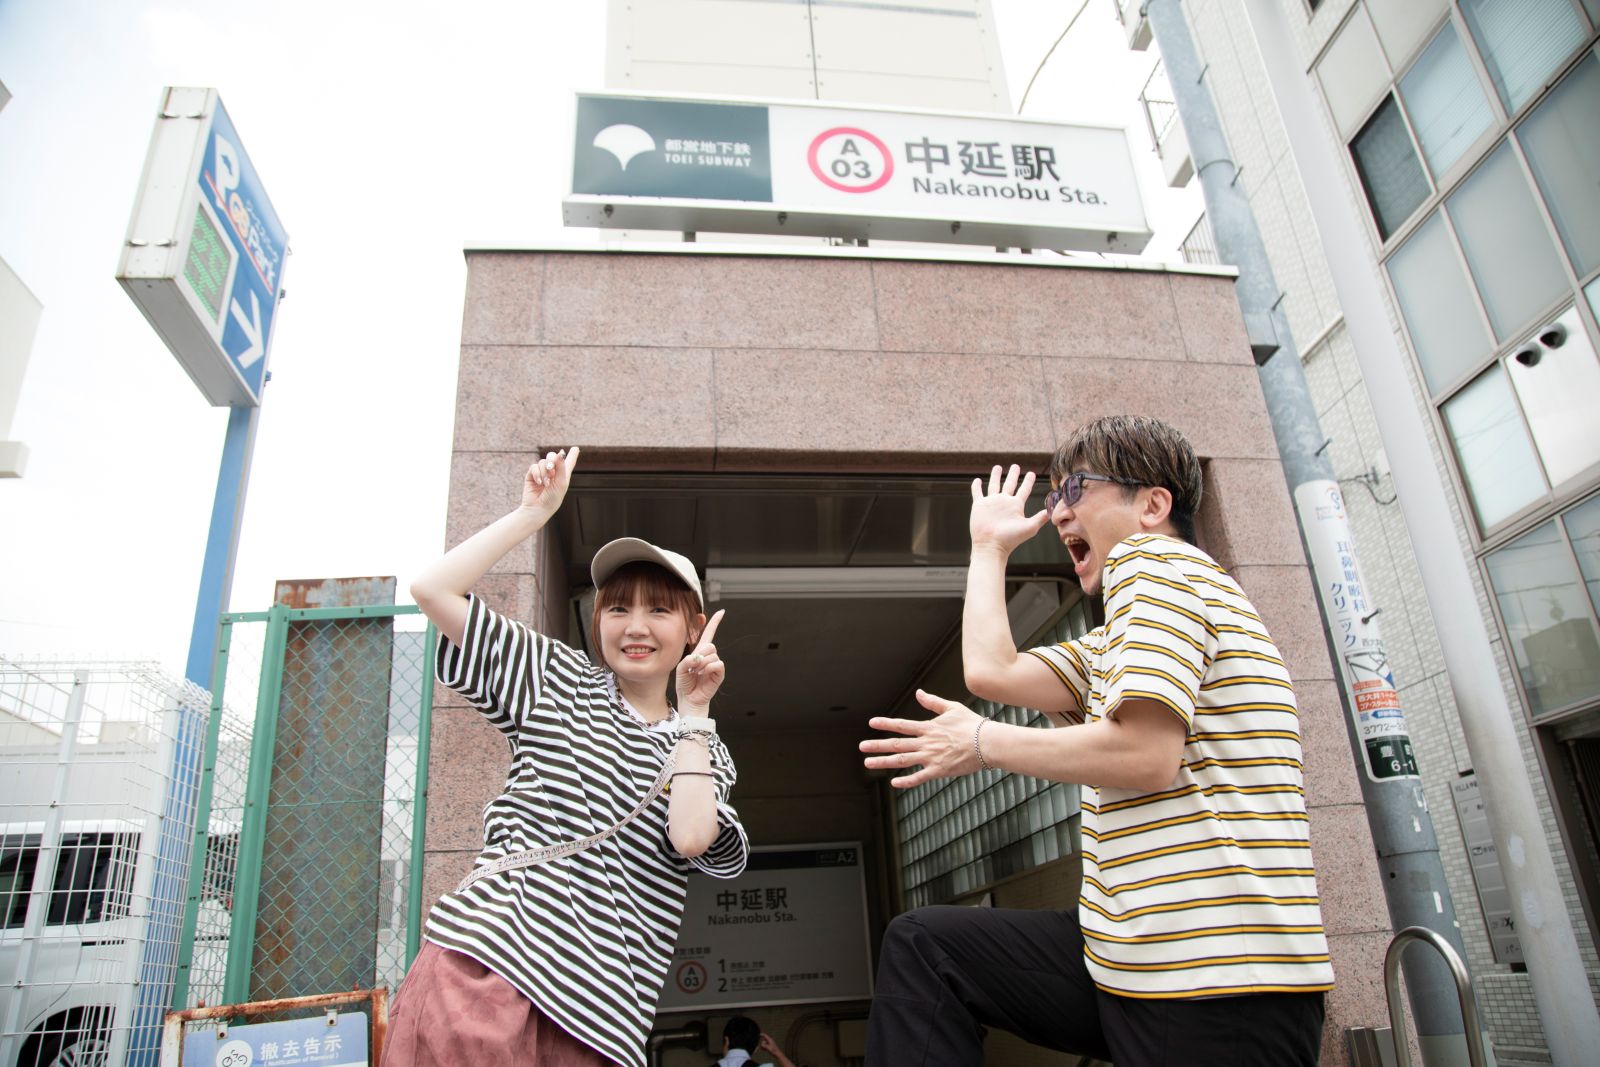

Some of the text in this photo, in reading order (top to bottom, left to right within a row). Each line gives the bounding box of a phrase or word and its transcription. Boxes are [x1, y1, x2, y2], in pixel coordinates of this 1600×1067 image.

[665, 138, 752, 156] 都営地下鉄
[840, 138, 861, 156] A
[664, 153, 752, 167] TOEI SUBWAY
[904, 136, 1060, 182] 中延駅
[831, 159, 872, 180] 03
[912, 177, 1108, 206] Nakanobu Sta.
[1330, 583, 1357, 647] クリニック
[837, 851, 855, 863] A2
[716, 888, 788, 912] 中延駅
[708, 911, 797, 926] Nakanobu Sta.
[688, 967, 696, 975] A
[717, 959, 726, 973] 1
[684, 977, 699, 987] 03
[718, 978, 728, 992] 2
[261, 1035, 342, 1061] 撤去告示
